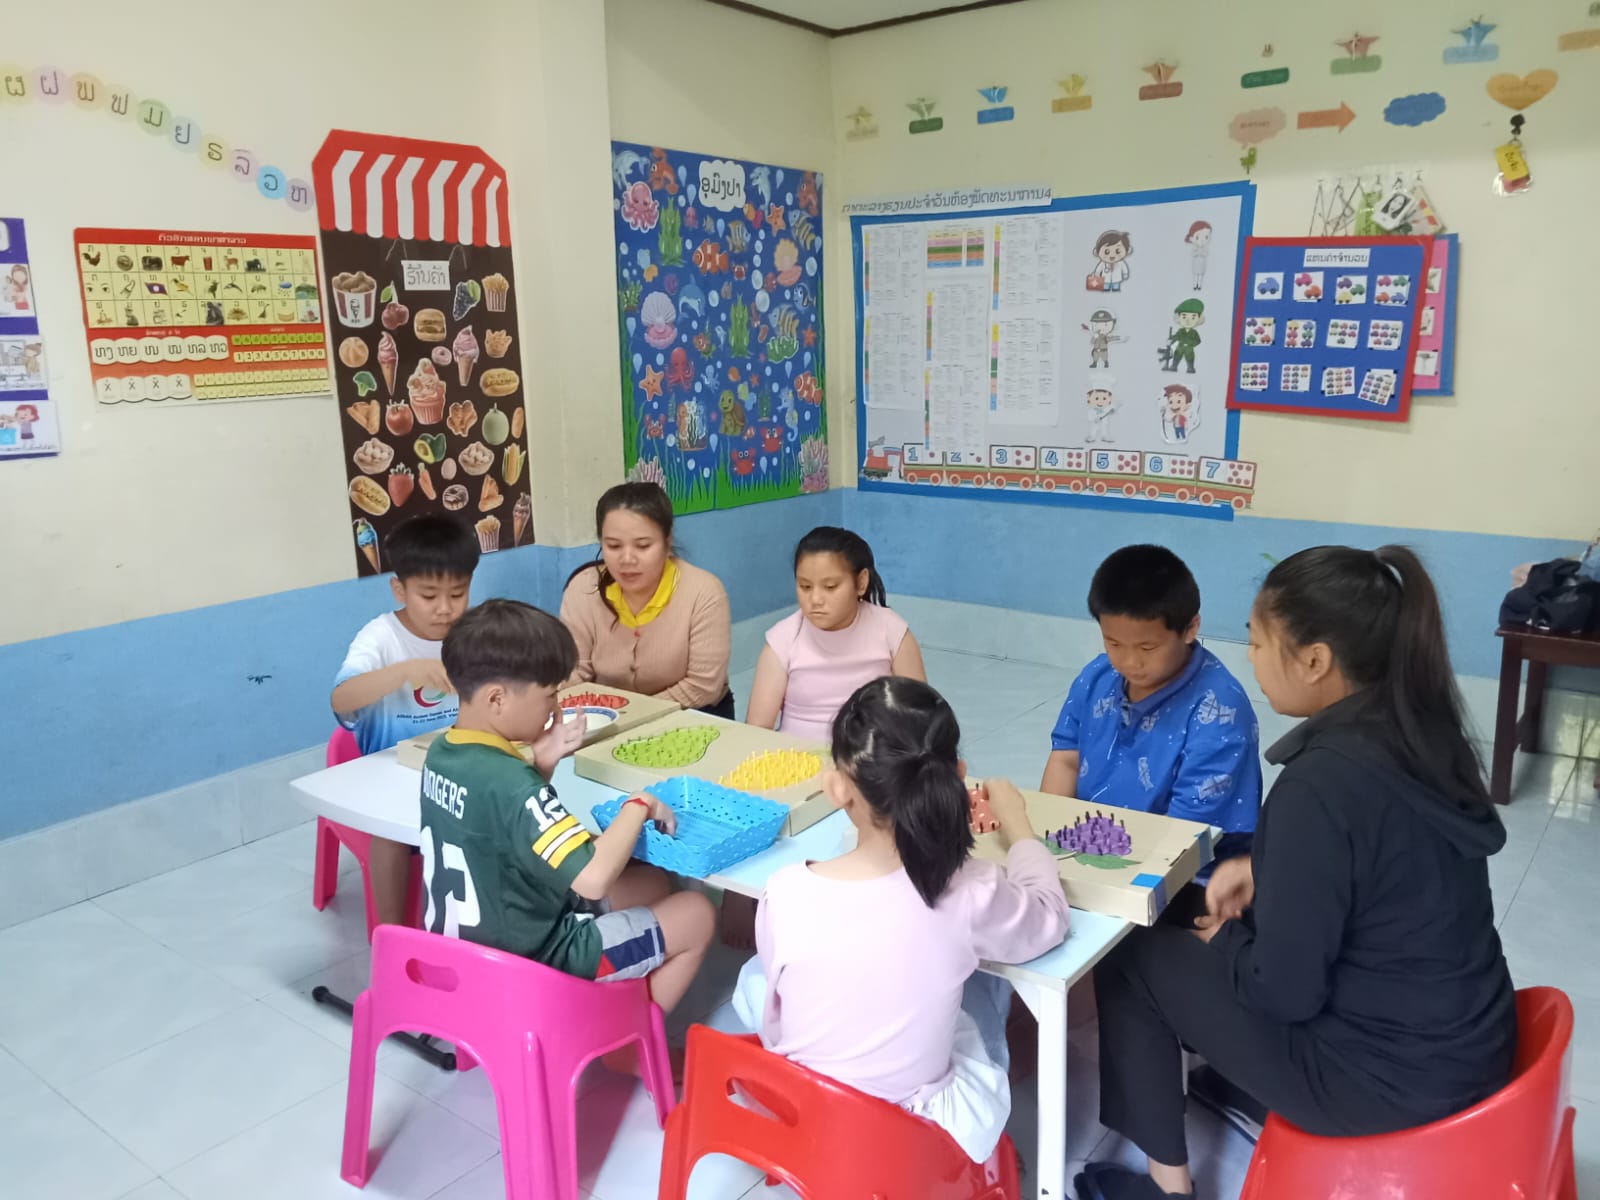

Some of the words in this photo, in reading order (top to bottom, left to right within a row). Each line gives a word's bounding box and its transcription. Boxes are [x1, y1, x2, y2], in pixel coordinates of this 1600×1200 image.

[908, 447, 918, 460] 1
[996, 449, 1007, 464] 3
[1045, 450, 1058, 466] 4
[1096, 453, 1109, 469] 5
[1150, 456, 1162, 472] 6
[1206, 462, 1220, 478] 7
[525, 786, 567, 832] 12
